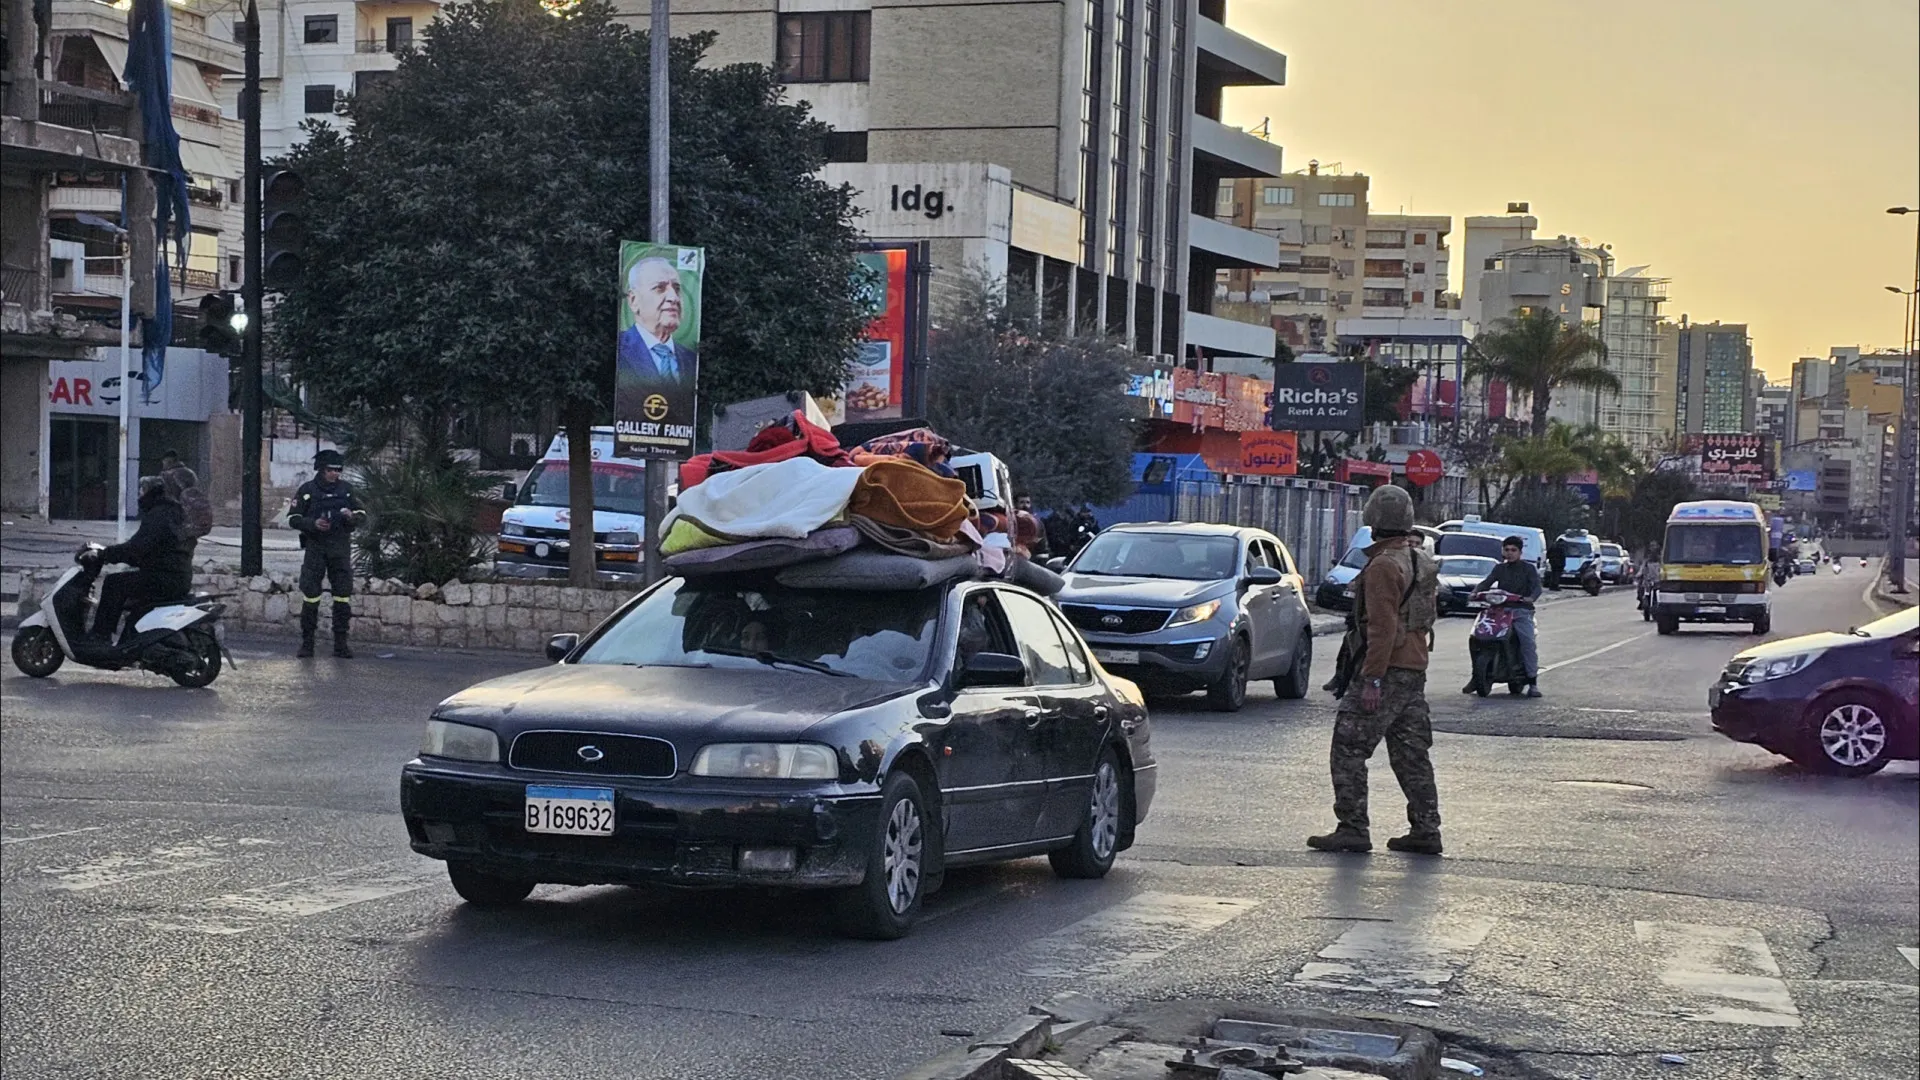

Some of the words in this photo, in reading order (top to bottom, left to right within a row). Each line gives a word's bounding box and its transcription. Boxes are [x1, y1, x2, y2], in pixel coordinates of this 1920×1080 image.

[49, 376, 93, 406] AR
[1288, 406, 1313, 416] Rent
[1316, 406, 1325, 416] A
[1328, 406, 1348, 416] Car
[616, 420, 660, 436] GALLERY
[664, 423, 693, 438] FAKIH
[630, 444, 647, 453] Saint
[1708, 447, 1757, 460] كاليري
[1243, 452, 1291, 468] الزغلول
[1103, 616, 1120, 625] KIA
